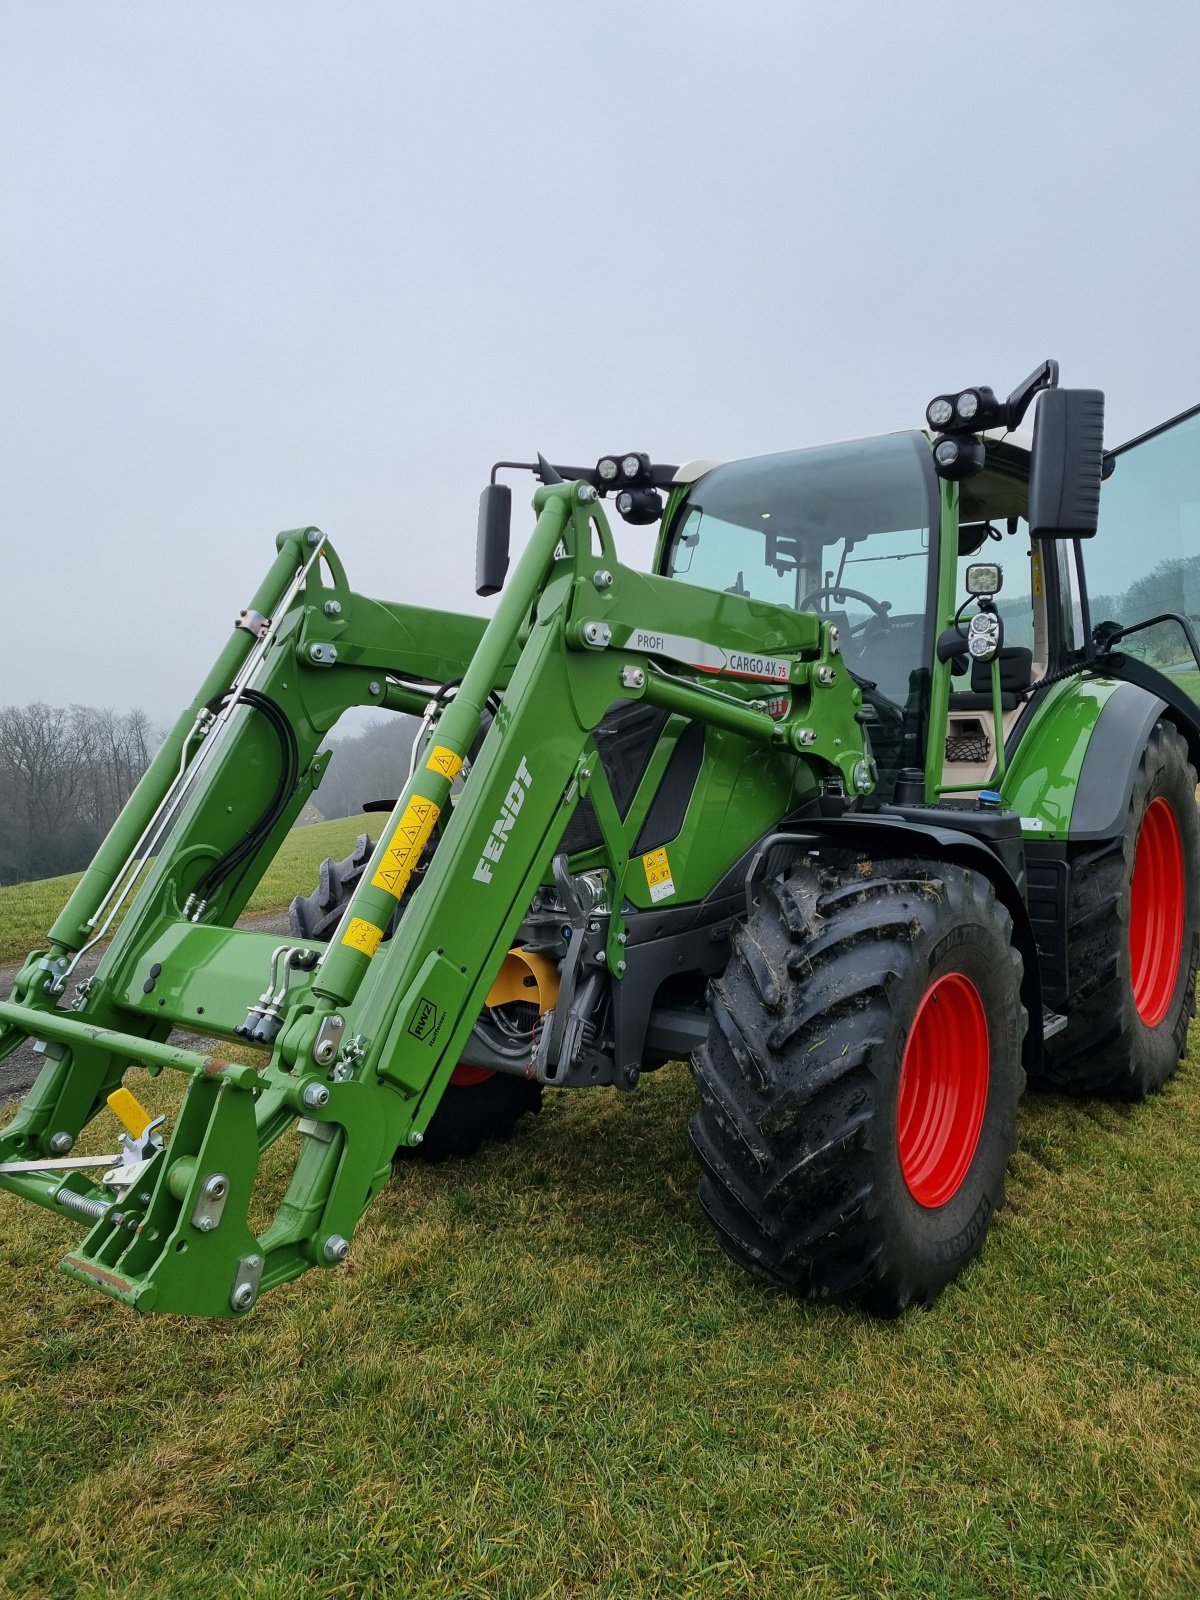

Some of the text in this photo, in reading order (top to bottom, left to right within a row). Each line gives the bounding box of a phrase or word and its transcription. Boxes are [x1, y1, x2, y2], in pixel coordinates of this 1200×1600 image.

[637, 634, 664, 650] PROFI
[729, 655, 786, 677] CARGO 4X 75
[472, 755, 533, 884] FENDT
[414, 1003, 433, 1036] RWZ
